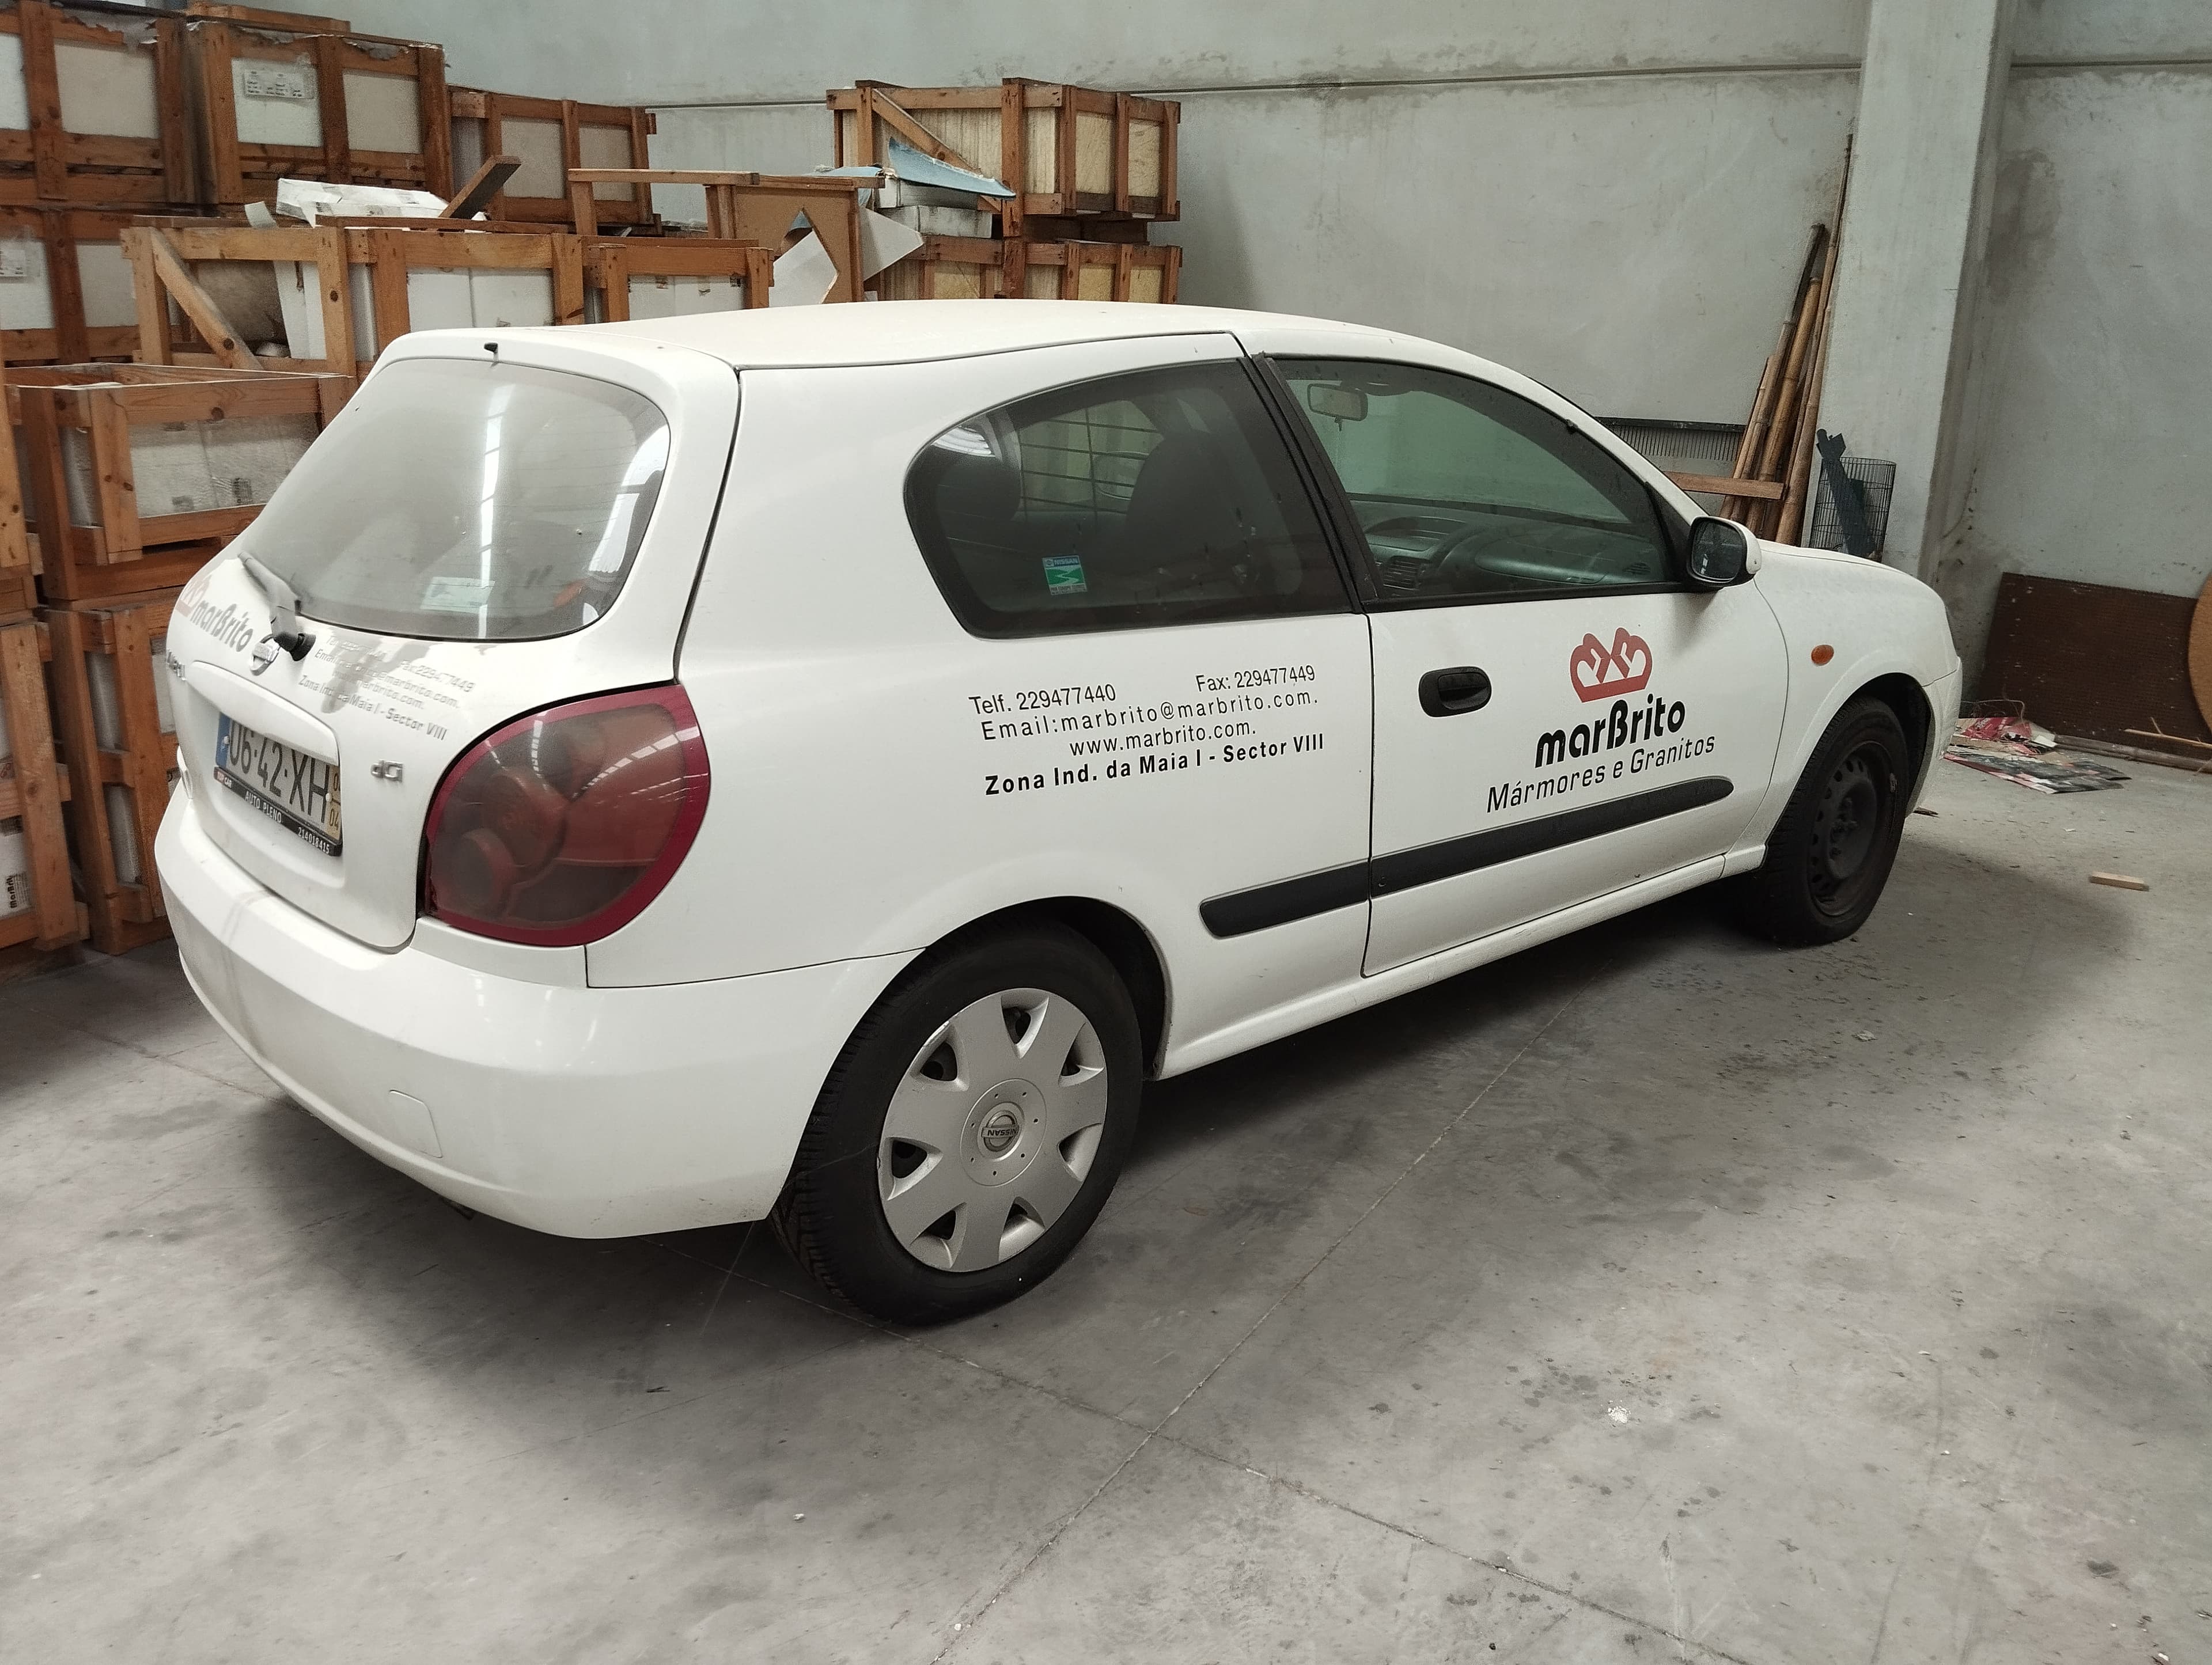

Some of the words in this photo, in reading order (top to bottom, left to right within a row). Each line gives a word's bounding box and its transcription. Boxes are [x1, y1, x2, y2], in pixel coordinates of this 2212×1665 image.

[1195, 674, 1231, 692] Fax:
[1234, 665, 1316, 688] 229477449
[968, 693, 1012, 715] Telf.
[1016, 684, 1116, 710] 229477440
[349, 693, 374, 712] Maia
[385, 708, 423, 731] Sector
[425, 722, 448, 741] VIII
[1069, 721, 1256, 756] www.marbrito.com.
[985, 773, 1045, 795] Zona
[1054, 763, 1097, 786] Ind.
[1106, 759, 1131, 779] da
[1139, 752, 1188, 775] Maia
[1195, 749, 1201, 767] I
[1223, 741, 1287, 763] Sector
[1293, 733, 1324, 753] VIII
[1486, 764, 1605, 813] Mármores
[1612, 760, 1623, 779] e
[1630, 735, 1715, 773] Granitos
[245, 791, 260, 809] AUTO
[263, 802, 282, 824] PLENO
[329, 808, 339, 831] 04
[298, 826, 330, 855] 214018415
[987, 1128, 1018, 1136] NISSAN
